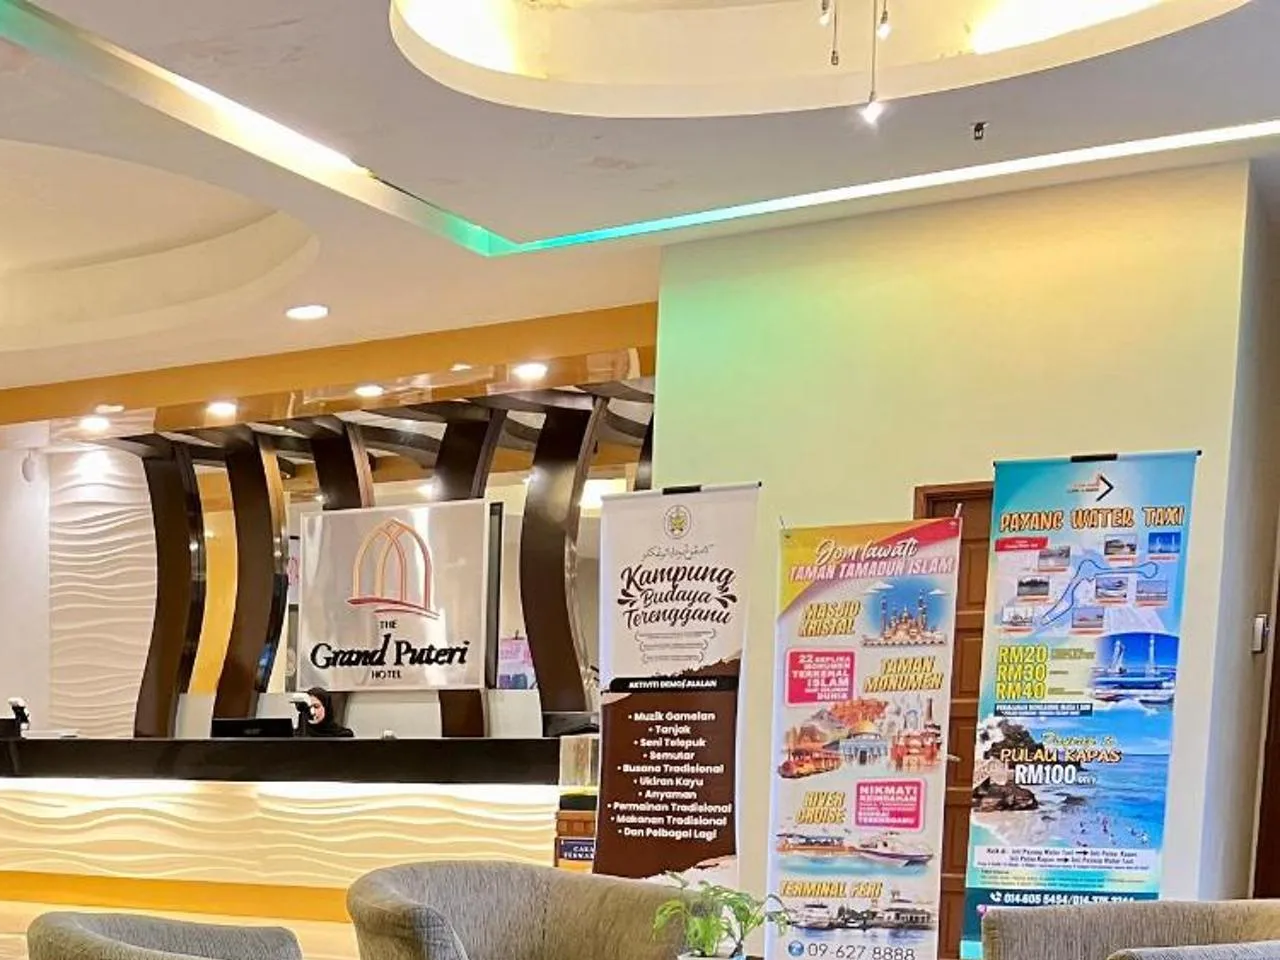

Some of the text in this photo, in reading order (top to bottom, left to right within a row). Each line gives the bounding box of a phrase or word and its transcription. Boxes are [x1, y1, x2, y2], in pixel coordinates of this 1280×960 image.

[1000, 506, 1185, 532] PAYANG WATER TAXI
[789, 557, 955, 582] TAMAN TAMADUN ISLAM
[620, 564, 737, 594] Kampung
[640, 587, 713, 609] Budaya
[380, 619, 397, 629] THE
[623, 607, 732, 630] Terengganu
[310, 633, 391, 669] Grand
[393, 640, 470, 666] Puteri
[999, 646, 1048, 663] RM20
[881, 657, 935, 675] TAMAN
[997, 663, 1046, 682] RM30
[371, 670, 402, 679] HOTEL
[629, 681, 659, 689] AKTIVITI
[807, 678, 849, 687] ISLAM
[864, 673, 944, 693] MONUMEN
[995, 681, 1045, 700] RM40
[634, 711, 716, 721] Muzik Gamelan
[655, 724, 691, 736] Tanjak
[640, 738, 663, 747] Seni
[649, 751, 695, 760] Semutar
[1001, 748, 1122, 763] PULAU KAPAS
[623, 764, 724, 774] Busana Tradisional
[1015, 764, 1076, 784] RM100
[639, 777, 704, 788] Ukiran Kayu
[860, 785, 917, 795] NIKMATI
[645, 790, 697, 800] Anyaman
[805, 792, 845, 807] RIVER
[613, 802, 732, 813] Permainan Tradisional
[616, 815, 727, 826] Makanan Tradisional
[796, 807, 846, 824] CRUISE
[624, 827, 717, 841] Dan Pelbagai Lagi
[781, 882, 883, 897] TERMINAL FERI
[808, 943, 866, 960] 09-627
